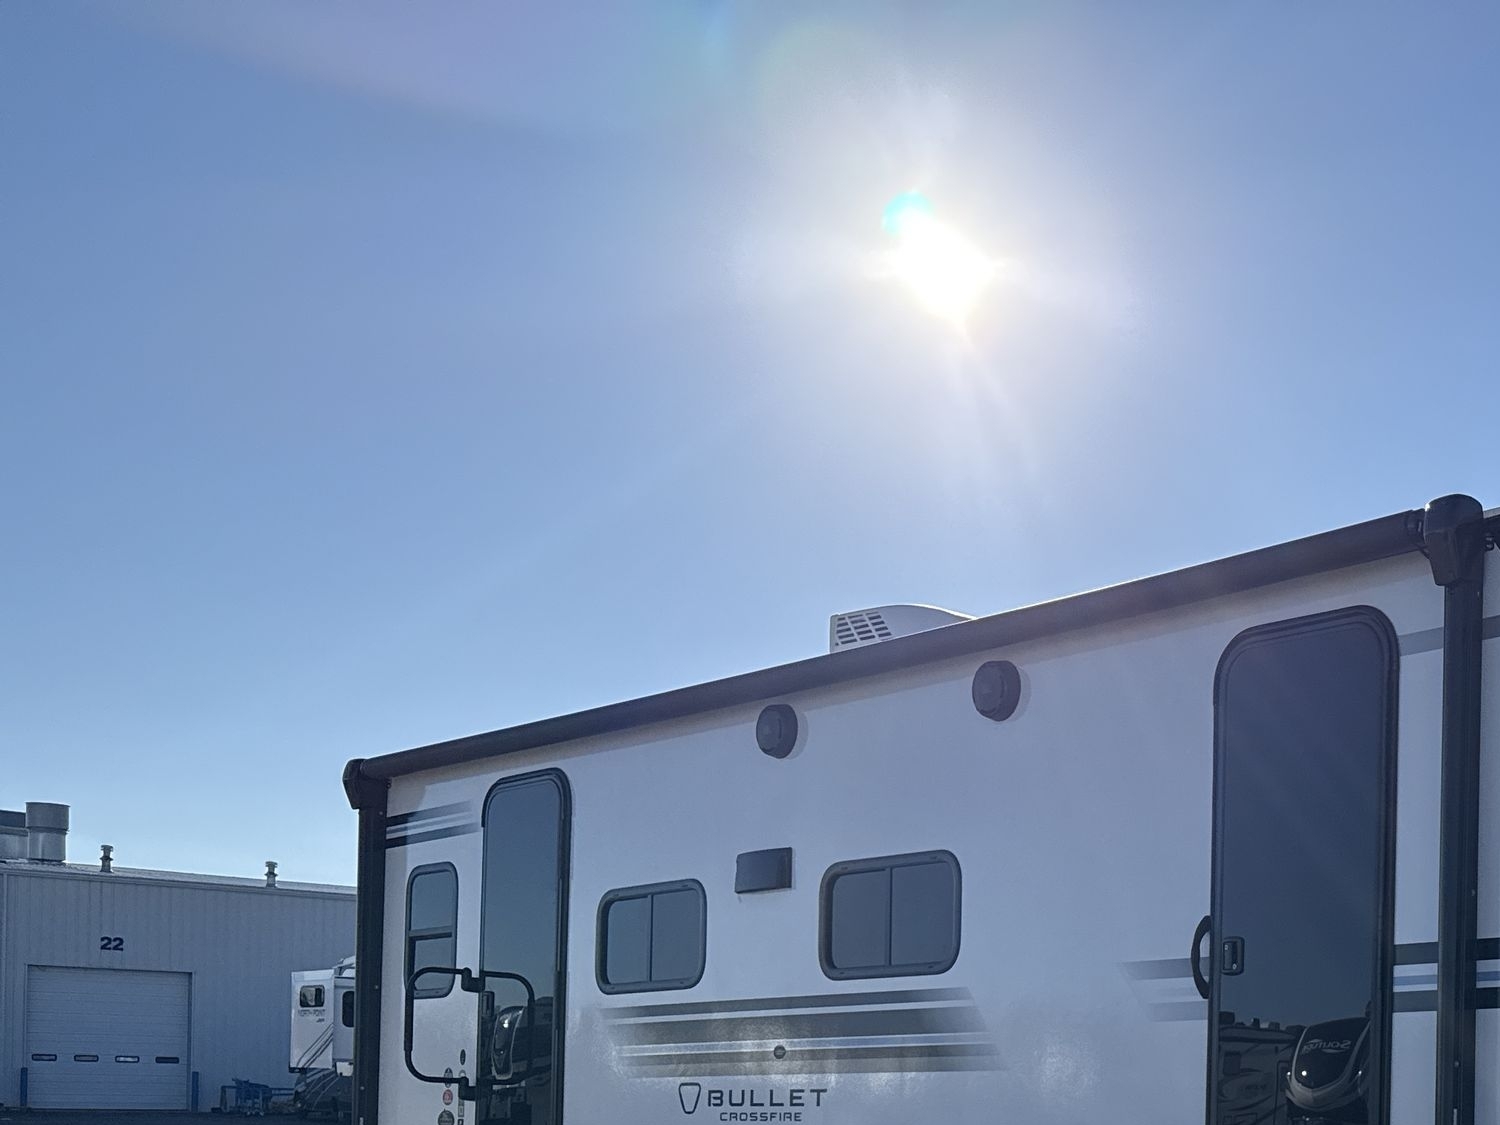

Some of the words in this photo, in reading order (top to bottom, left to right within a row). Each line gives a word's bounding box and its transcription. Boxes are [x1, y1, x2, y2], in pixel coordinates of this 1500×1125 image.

[100, 936, 124, 951] 22
[707, 1088, 828, 1107] BULLET
[719, 1111, 802, 1122] CROSSFIRE
